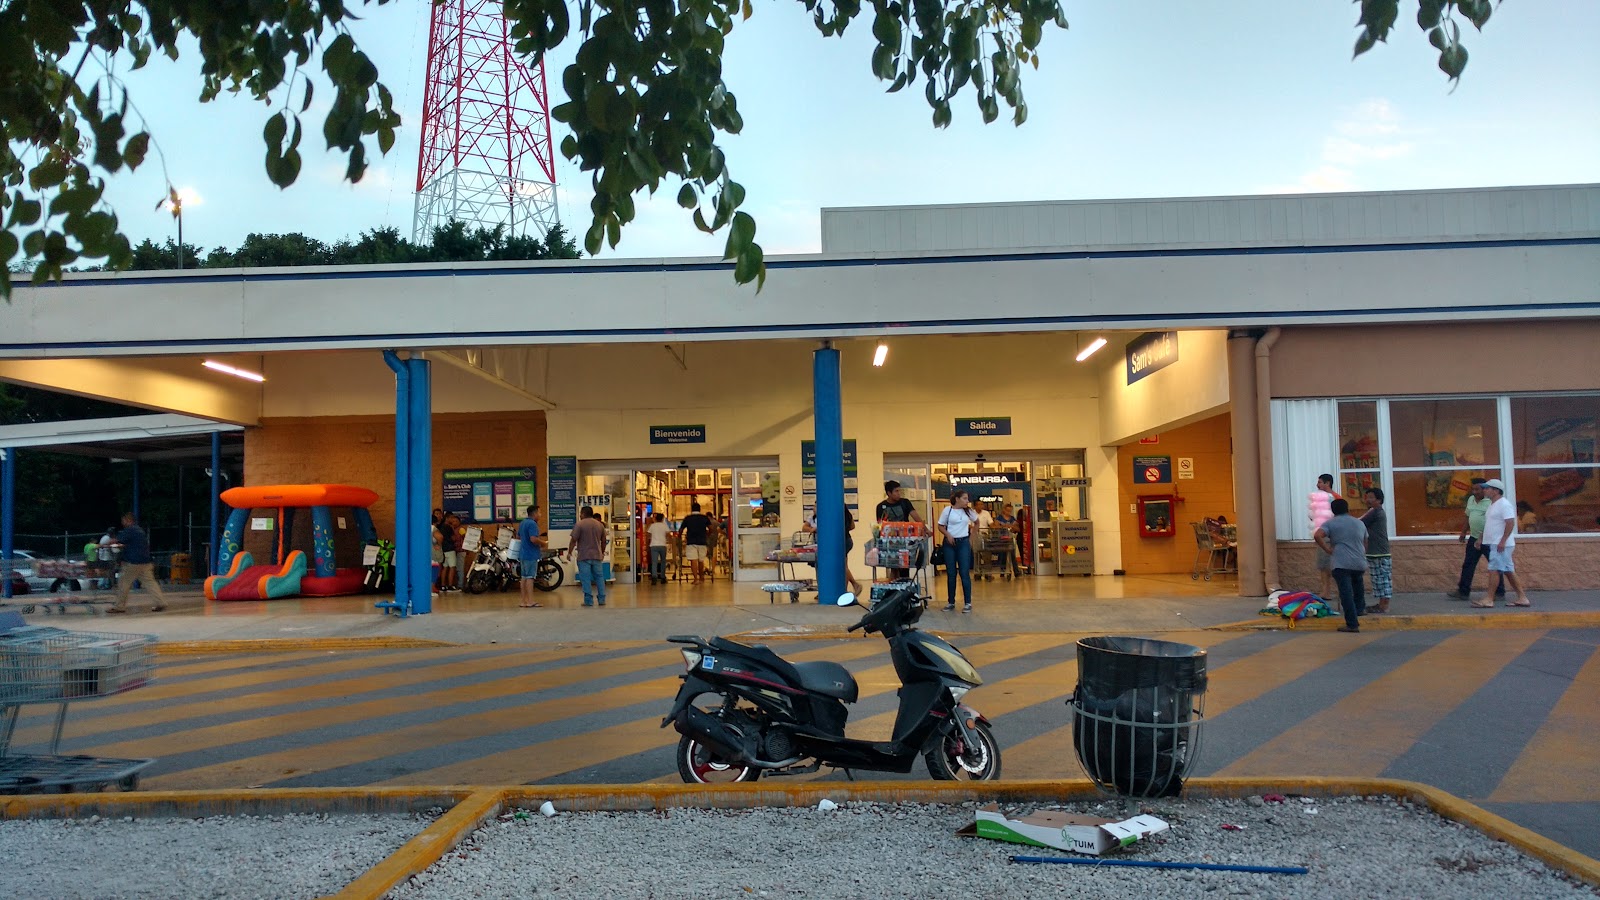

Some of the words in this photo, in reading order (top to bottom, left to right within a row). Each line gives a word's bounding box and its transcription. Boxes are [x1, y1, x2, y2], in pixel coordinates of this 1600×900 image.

[1131, 345, 1152, 374] Sam's
[969, 421, 997, 430] Salida
[654, 429, 701, 438] Bienvenido
[960, 475, 1010, 484] INBURSA
[578, 494, 610, 507] FLETES
[1074, 839, 1095, 849] TUIM
